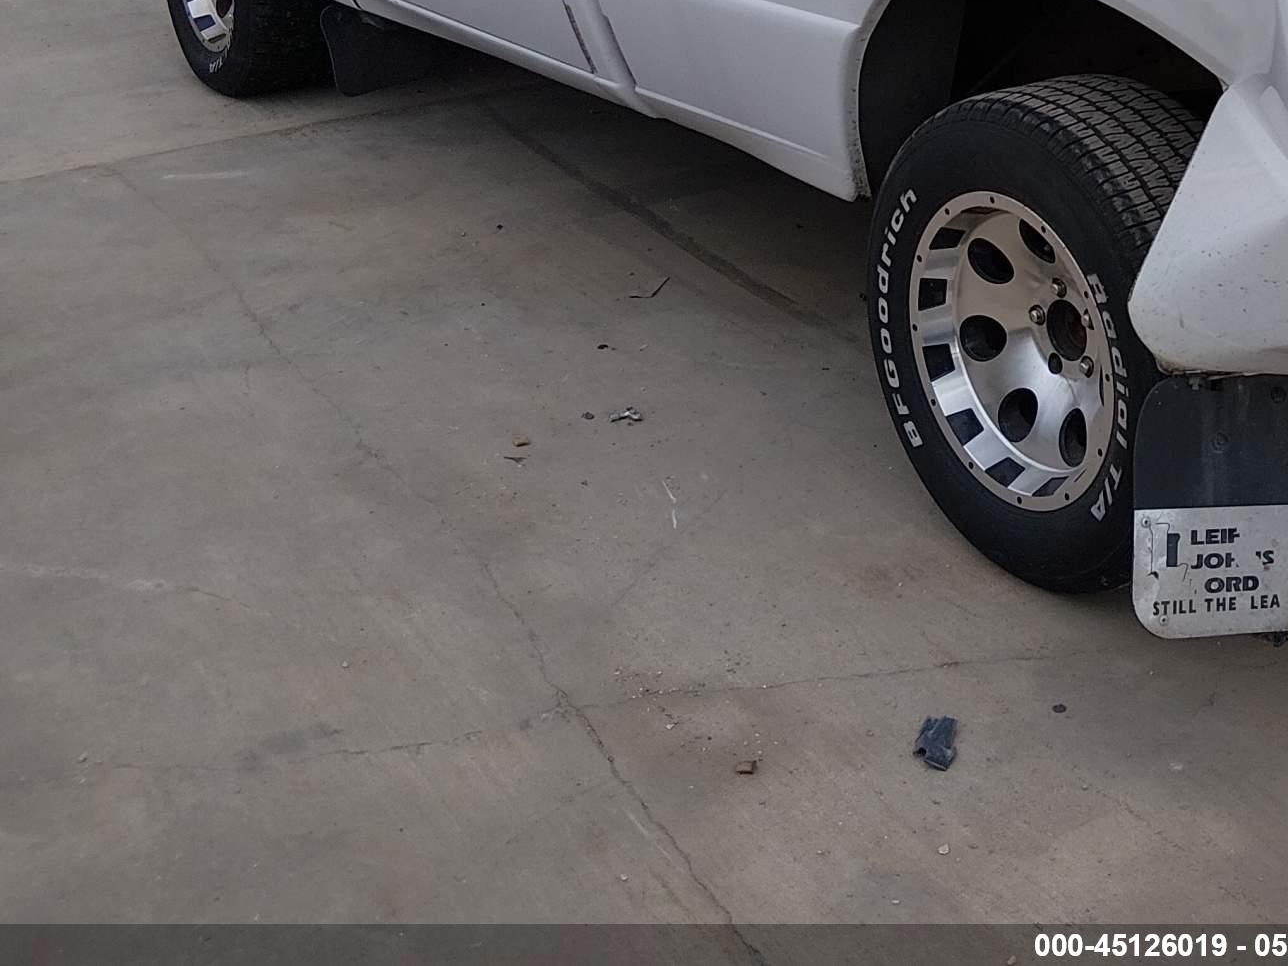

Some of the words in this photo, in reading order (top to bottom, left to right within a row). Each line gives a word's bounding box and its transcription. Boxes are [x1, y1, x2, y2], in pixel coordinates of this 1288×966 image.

[1204, 575, 1260, 594] ORD
[1152, 599, 1197, 616] STILL
[1204, 596, 1237, 612] THE
